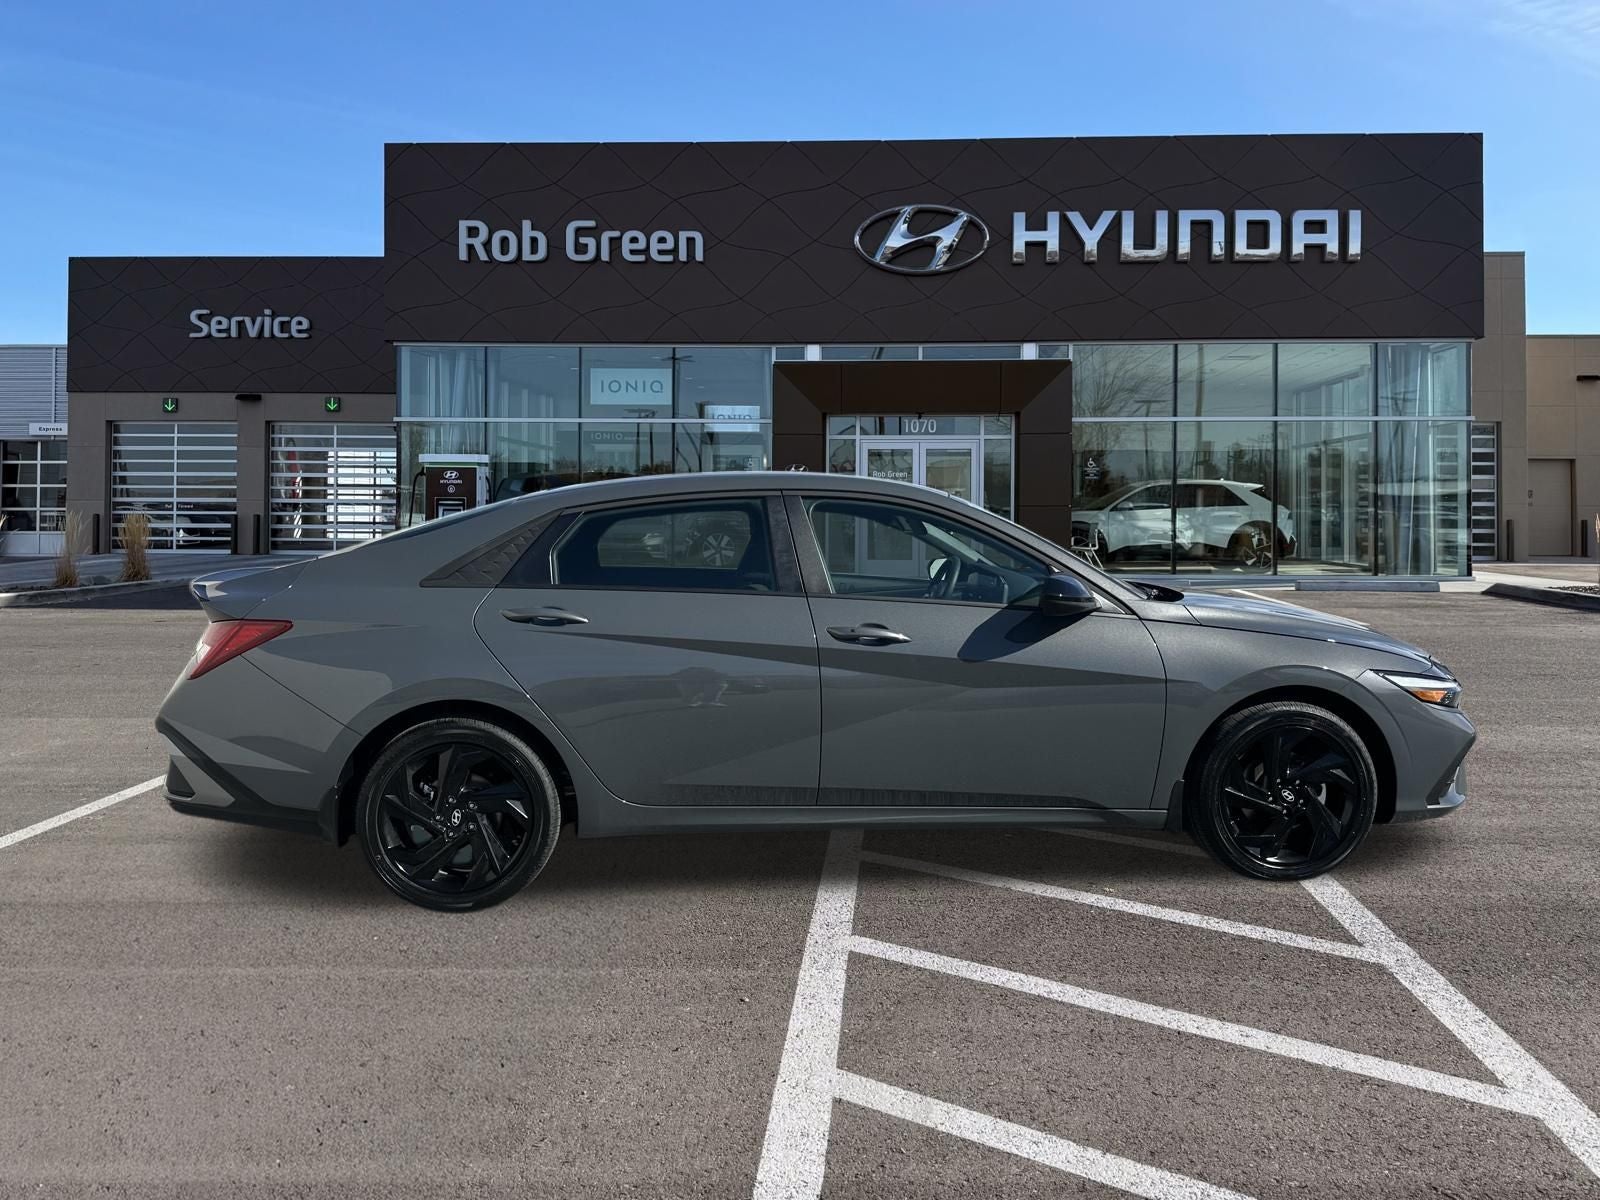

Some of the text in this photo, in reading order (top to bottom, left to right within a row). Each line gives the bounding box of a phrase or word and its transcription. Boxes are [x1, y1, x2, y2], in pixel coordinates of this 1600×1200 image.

[458, 219, 705, 263] Rob Green
[1011, 209, 1362, 264] HYUNDAI
[188, 308, 310, 339] Service
[600, 380, 663, 394] IONIQ
[903, 419, 937, 433] 1070
[872, 470, 908, 478] Rob Green
